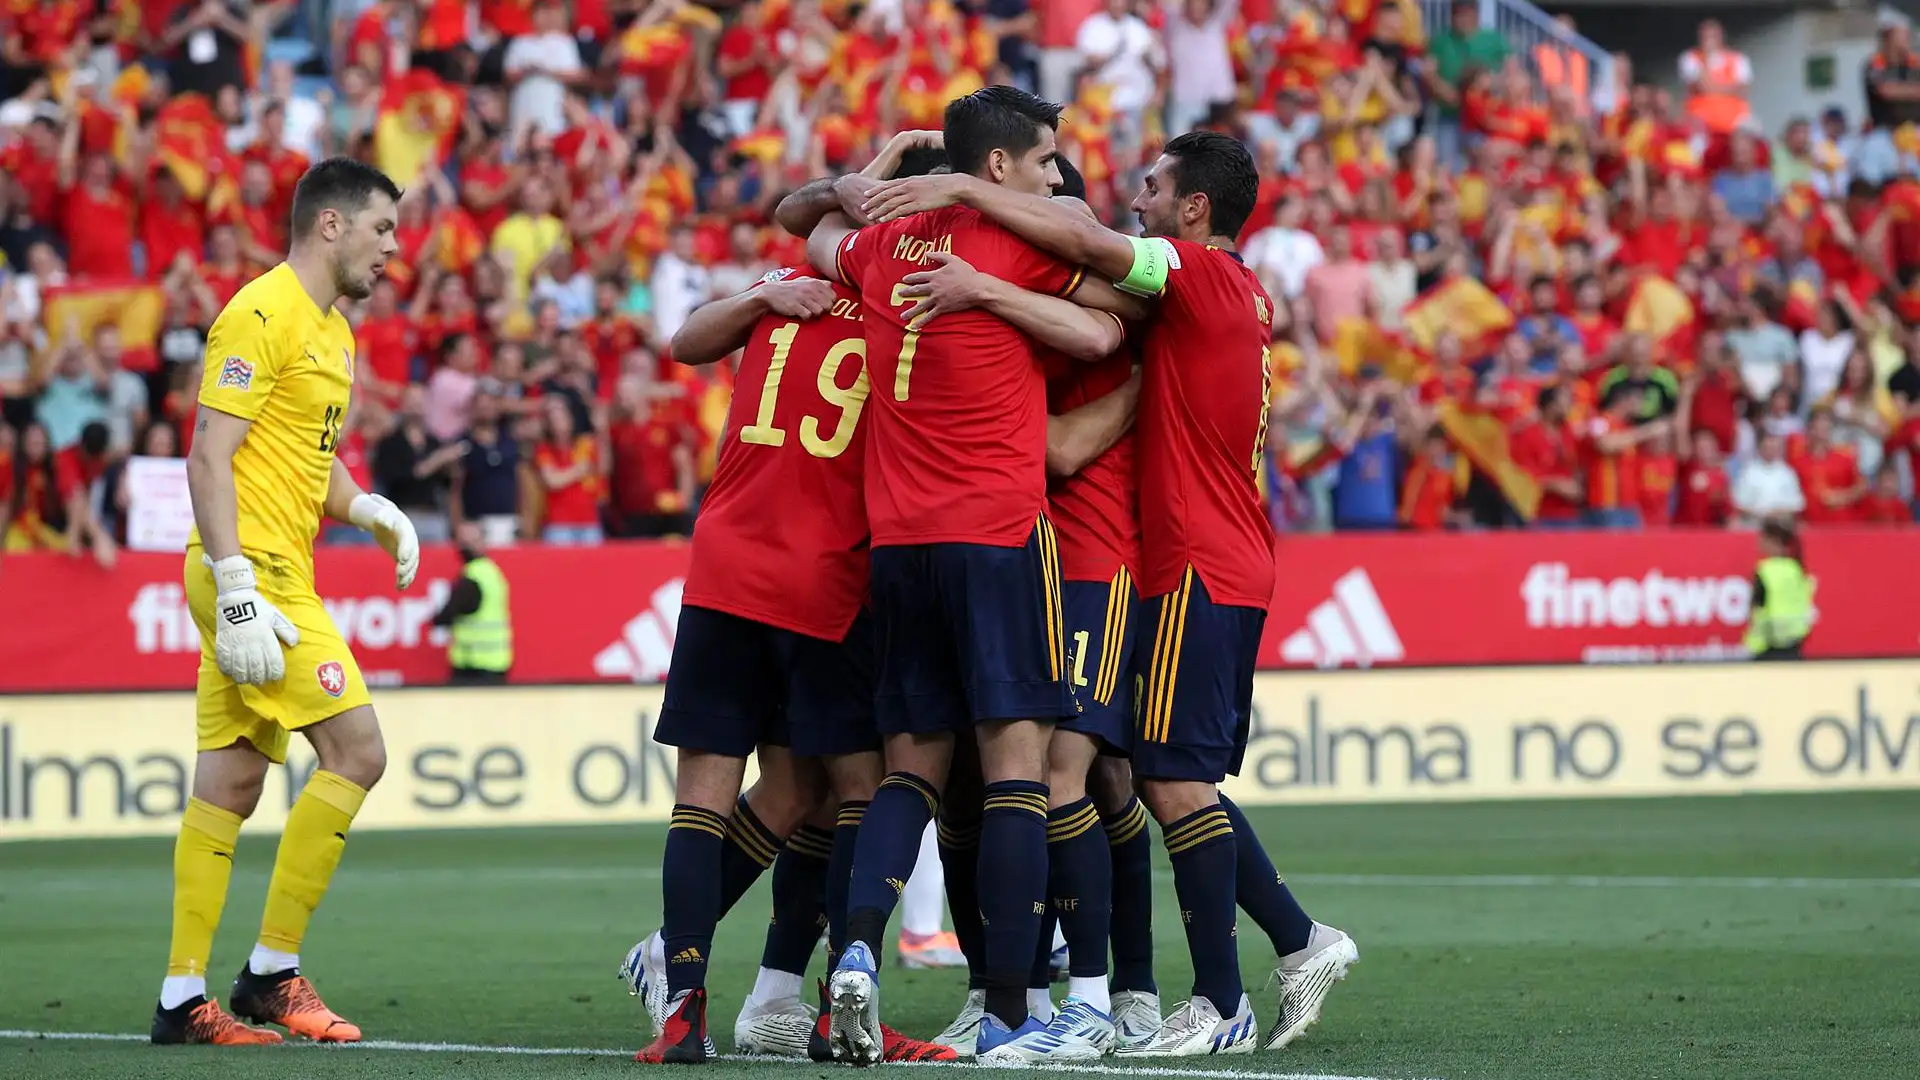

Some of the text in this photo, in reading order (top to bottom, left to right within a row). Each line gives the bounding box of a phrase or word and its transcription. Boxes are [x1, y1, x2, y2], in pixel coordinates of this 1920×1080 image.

[740, 322, 871, 459] 19
[891, 283, 928, 402] 7
[1521, 564, 1752, 628] finetwo
[0, 723, 187, 820] lma
[411, 747, 525, 809] se
[1511, 720, 1620, 781] no
[1661, 717, 1759, 778] se
[1801, 685, 1920, 776] olv
